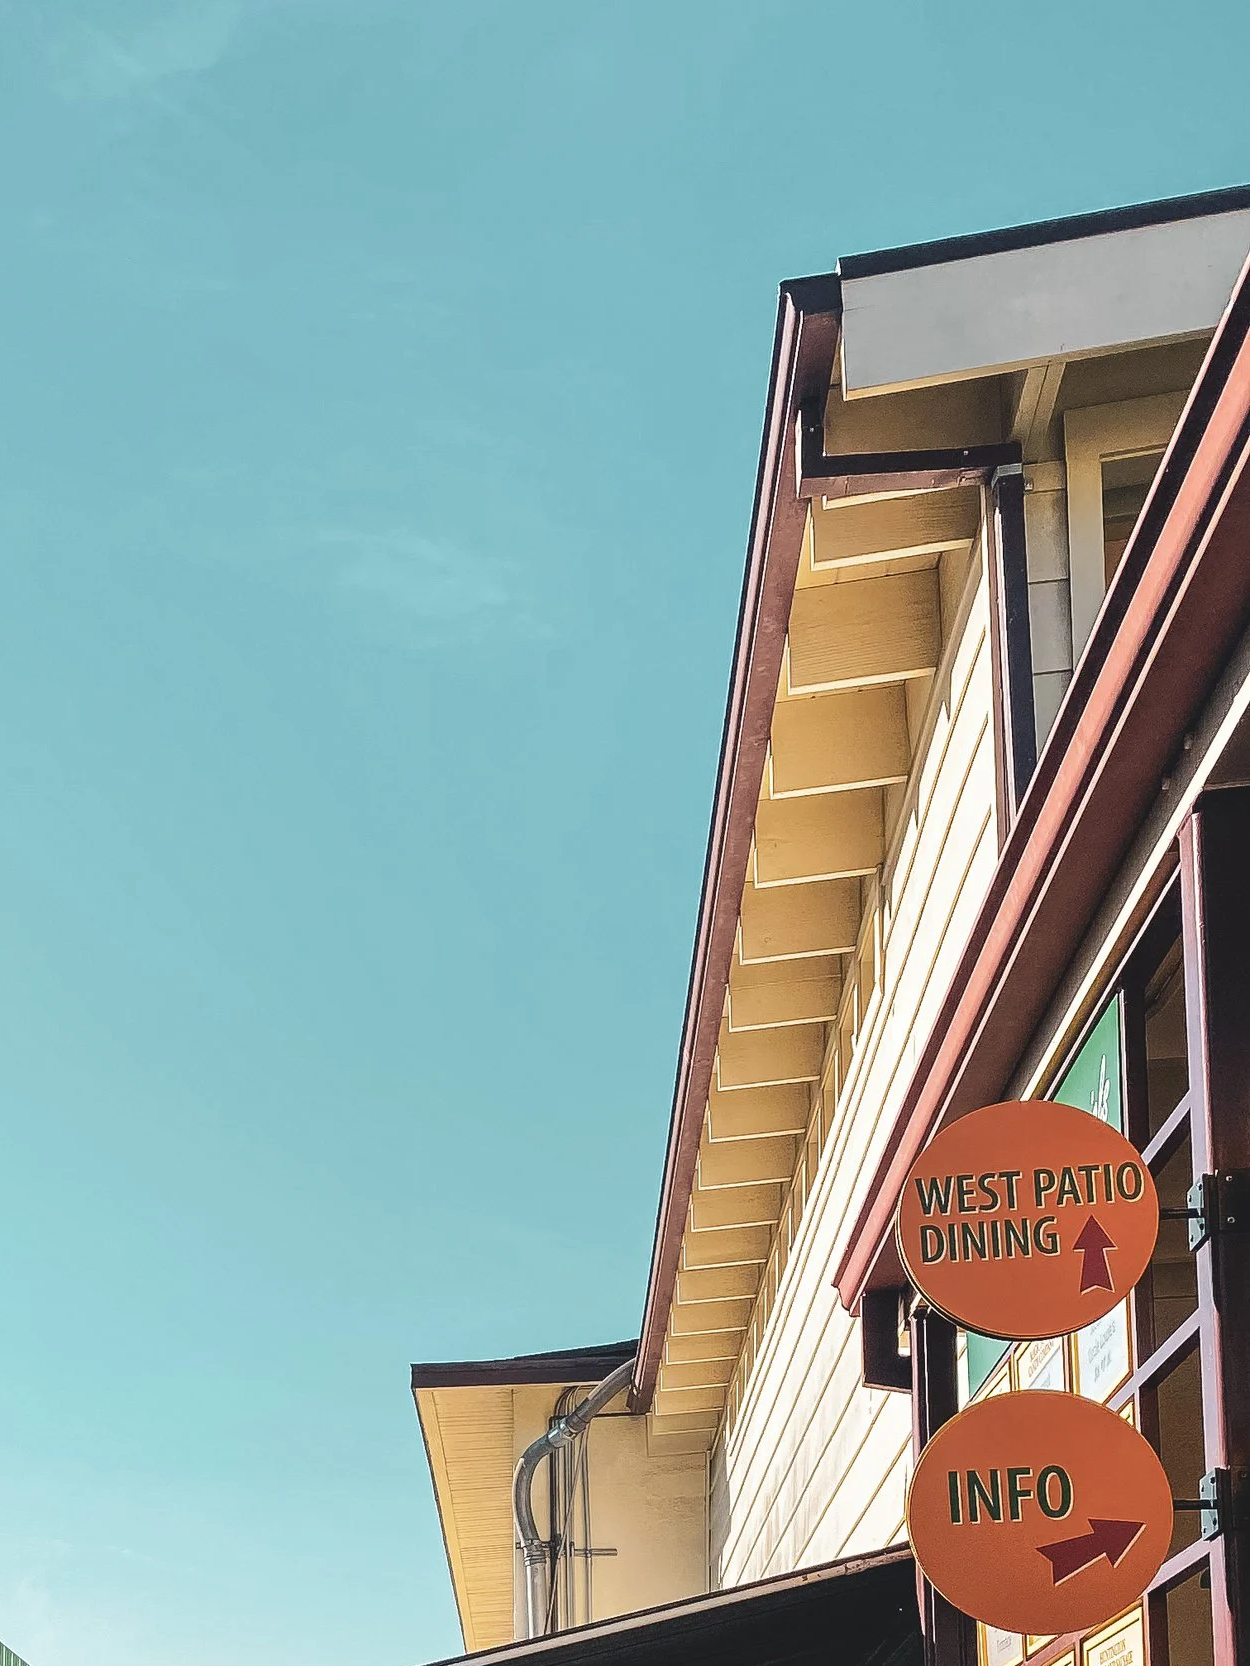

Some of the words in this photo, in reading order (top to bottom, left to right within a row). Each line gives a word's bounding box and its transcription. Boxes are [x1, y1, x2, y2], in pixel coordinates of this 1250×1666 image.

[914, 1170, 1021, 1217] WEST
[1033, 1160, 1145, 1209] PATIO
[919, 1215, 1061, 1265] DINING
[948, 1463, 1075, 1526] INFO
